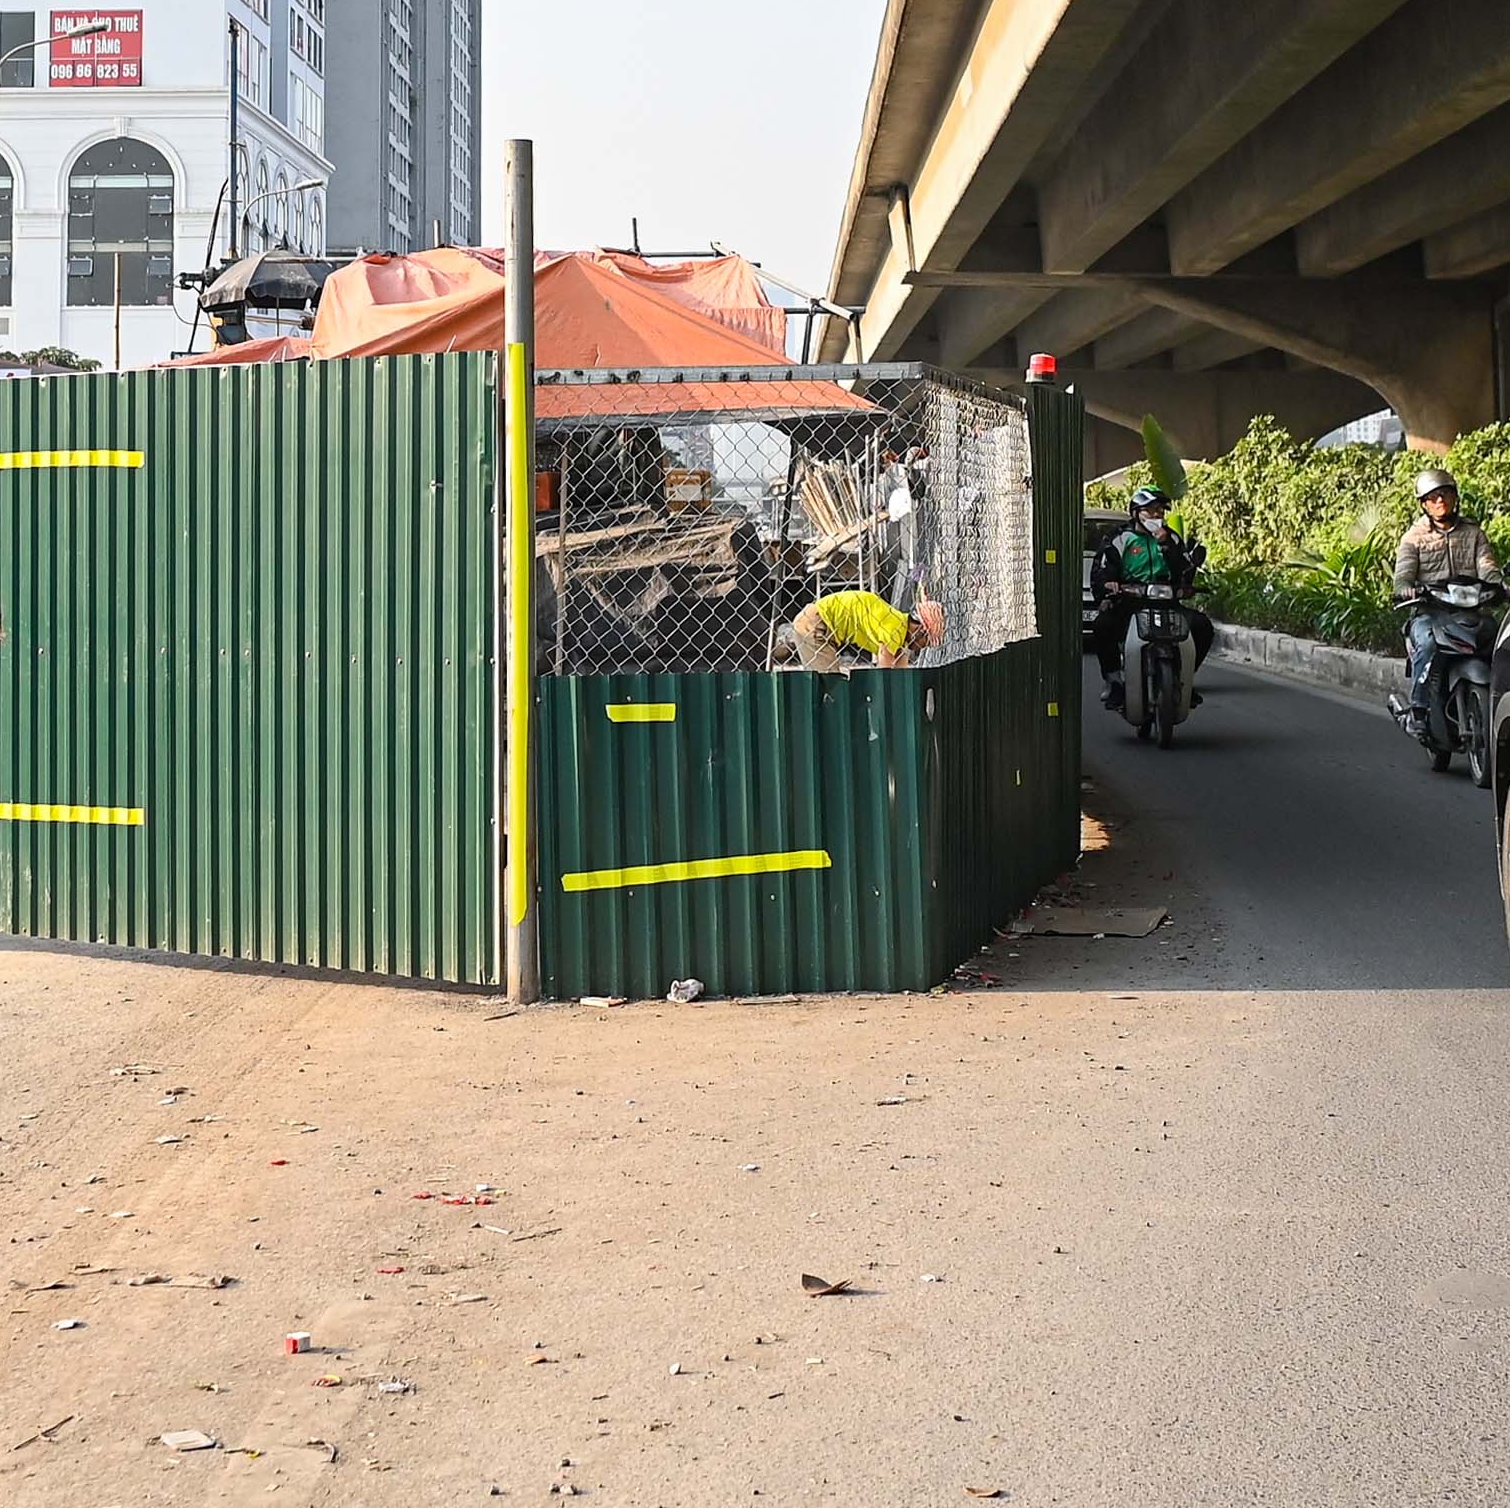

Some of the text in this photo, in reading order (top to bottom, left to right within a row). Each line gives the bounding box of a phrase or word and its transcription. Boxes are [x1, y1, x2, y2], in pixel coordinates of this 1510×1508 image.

[54, 14, 74, 33] BÁN
[114, 14, 139, 33] THUÊ
[71, 36, 92, 58] MẶT
[50, 63, 138, 79] 096 86 823 55
